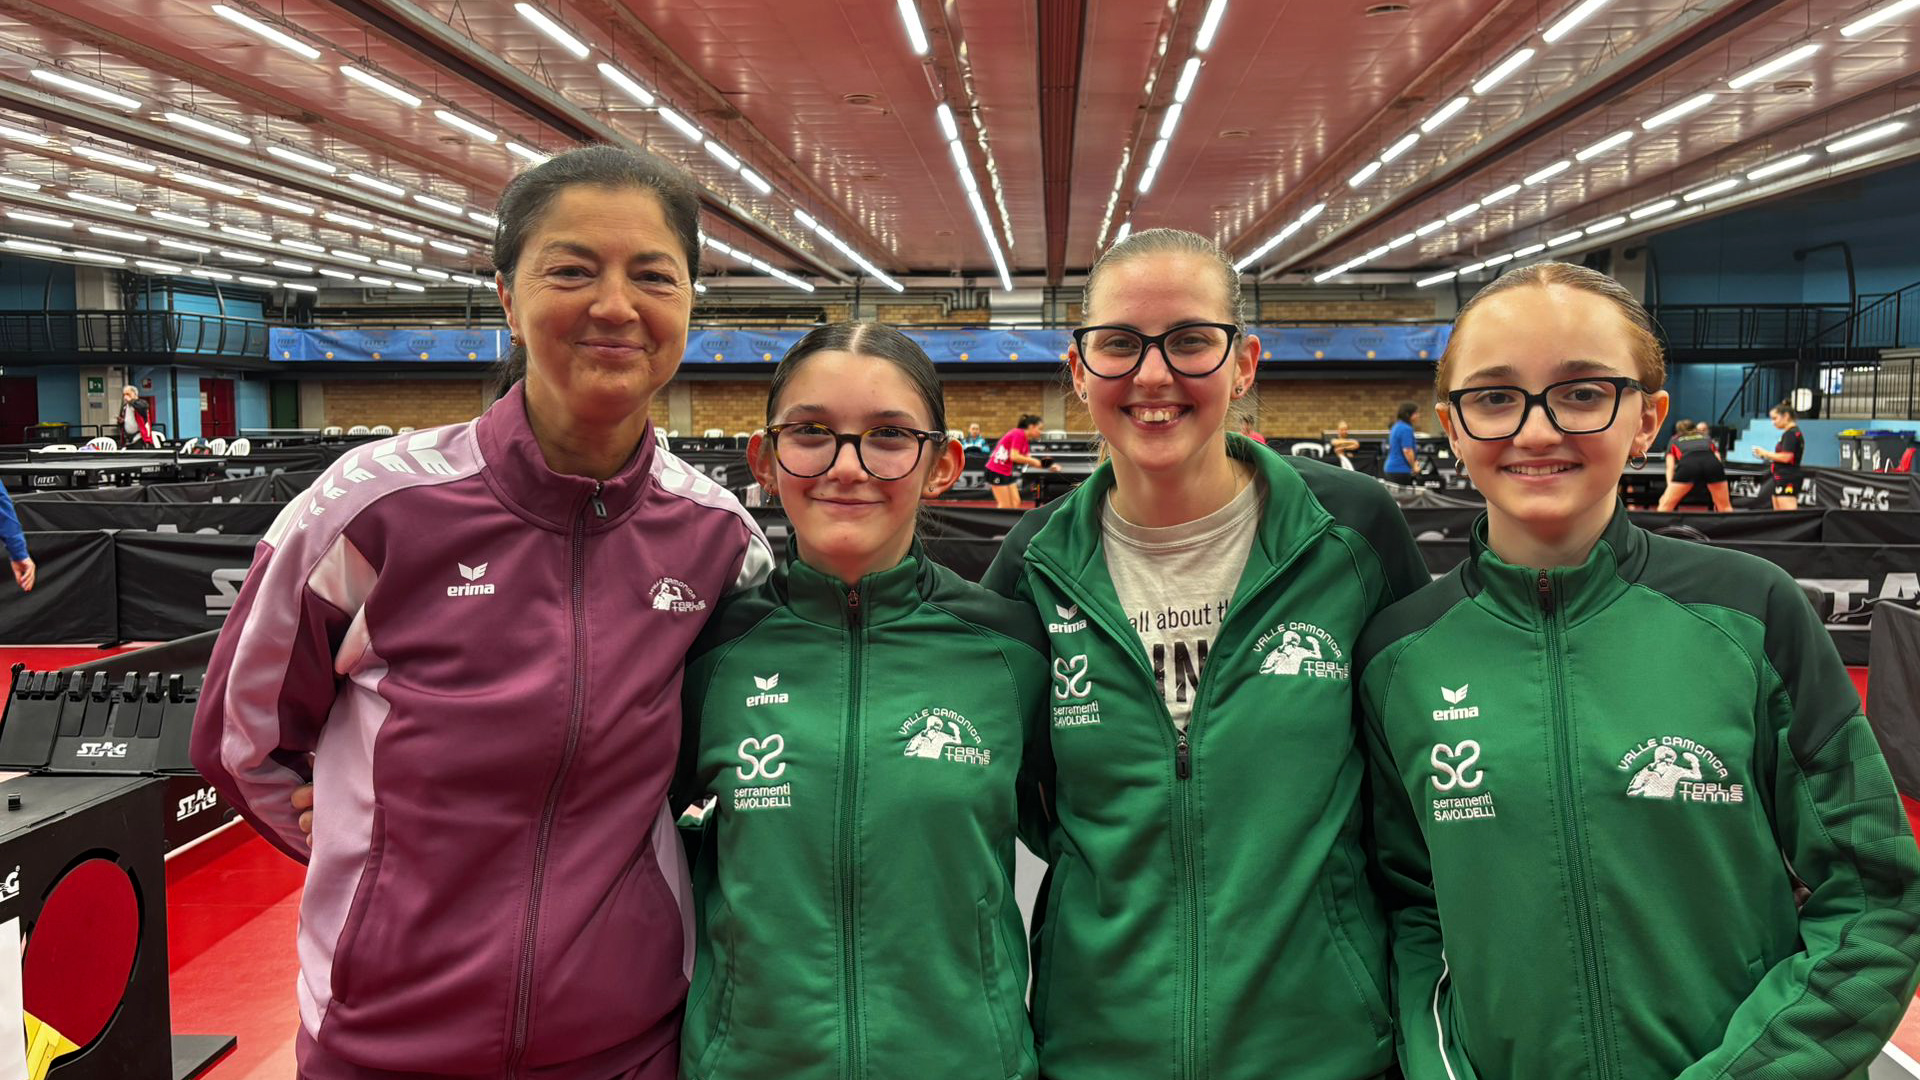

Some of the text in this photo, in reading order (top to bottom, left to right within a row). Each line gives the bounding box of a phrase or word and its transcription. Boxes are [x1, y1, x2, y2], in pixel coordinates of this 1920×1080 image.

[1840, 486, 1889, 511] STAG
[446, 582, 495, 597] erima
[1128, 610, 1149, 633] all
[1156, 603, 1212, 630] about
[1048, 619, 1088, 634] erima
[1253, 621, 1342, 659] VALLE CAMONICA
[1303, 660, 1349, 672] TABLE
[745, 692, 789, 708] erima
[1053, 700, 1099, 716] serramenti
[1054, 713, 1101, 728] SAVOLDELLI
[1432, 705, 1479, 721] erima
[898, 707, 982, 745] VALLE CAMONICA
[76, 742, 128, 758] STAG
[944, 745, 991, 757] TABLE
[1617, 735, 1729, 779] VALLE CAMONICA
[944, 753, 991, 766] TENNIS
[733, 782, 791, 798] serramenti
[1679, 781, 1744, 793] TABLE
[176, 786, 217, 822] STAG
[733, 796, 792, 810] SAVOLDELLI
[1433, 793, 1492, 810] serramenti
[1679, 790, 1744, 803] TENNIS
[1433, 807, 1496, 822] SAVOLDELLI
